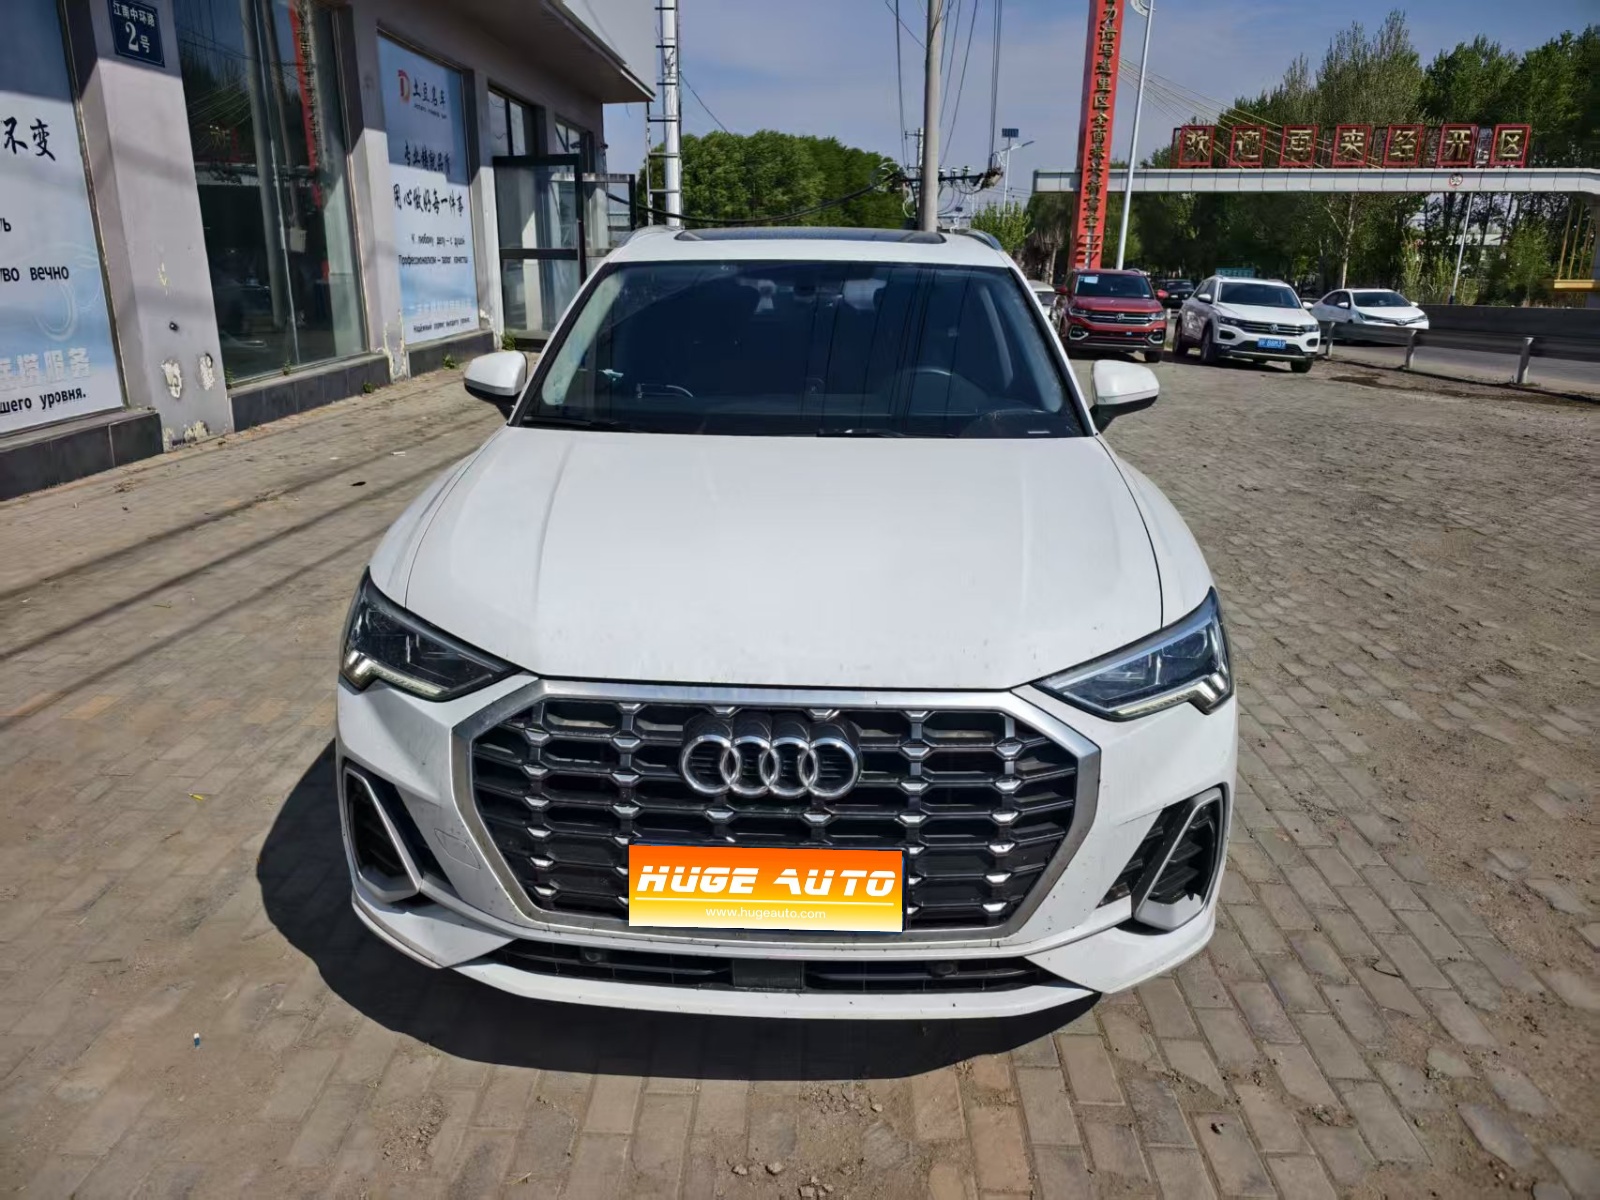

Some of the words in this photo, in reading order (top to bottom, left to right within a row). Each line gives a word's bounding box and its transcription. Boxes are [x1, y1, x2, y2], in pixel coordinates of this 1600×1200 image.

[125, 21, 151, 53] 2号
[30, 265, 70, 281] вечно
[39, 387, 87, 410] уровня.
